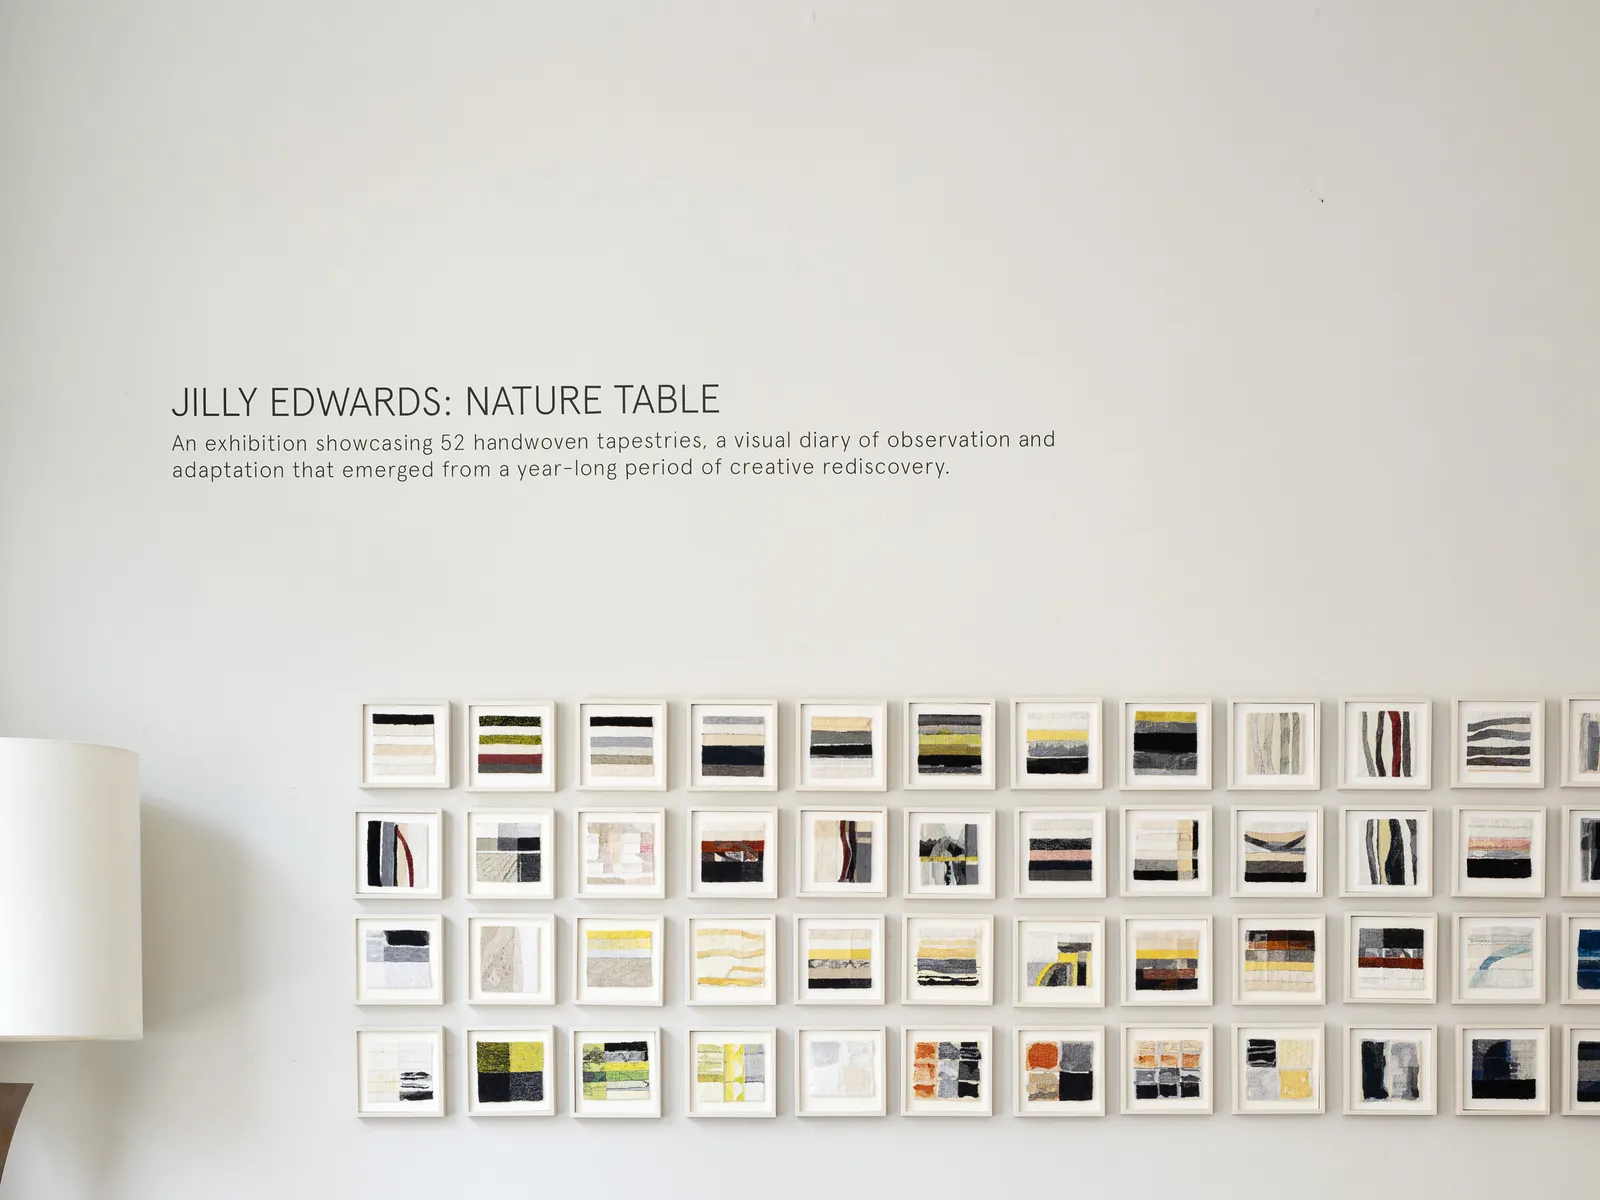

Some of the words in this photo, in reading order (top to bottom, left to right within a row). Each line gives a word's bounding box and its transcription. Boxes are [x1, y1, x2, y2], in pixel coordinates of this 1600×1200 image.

[171, 386, 258, 417] JILLY
[271, 386, 451, 417] EDWARDS:
[466, 384, 602, 417] NATURE
[613, 383, 720, 415] TABLE
[171, 434, 197, 452] An
[205, 434, 307, 452] exhibition
[316, 434, 433, 456] showcasing
[440, 433, 465, 452] 52
[474, 432, 589, 451] handwoven
[596, 430, 707, 454] tapestries,
[716, 435, 727, 449] a
[733, 430, 791, 449] visual
[799, 430, 851, 453] diary
[858, 430, 880, 449] of
[887, 430, 1010, 449] observation
[1018, 429, 1055, 448] and
[172, 460, 284, 483] adaptation
[292, 460, 335, 479] that
[342, 460, 434, 483] emerged
[442, 460, 491, 478] from
[499, 464, 510, 478] a
[516, 459, 618, 482] year-long
[625, 457, 693, 481] period
[701, 457, 723, 476] of
[729, 457, 815, 475] creative
[823, 457, 950, 480] rediscovery.
